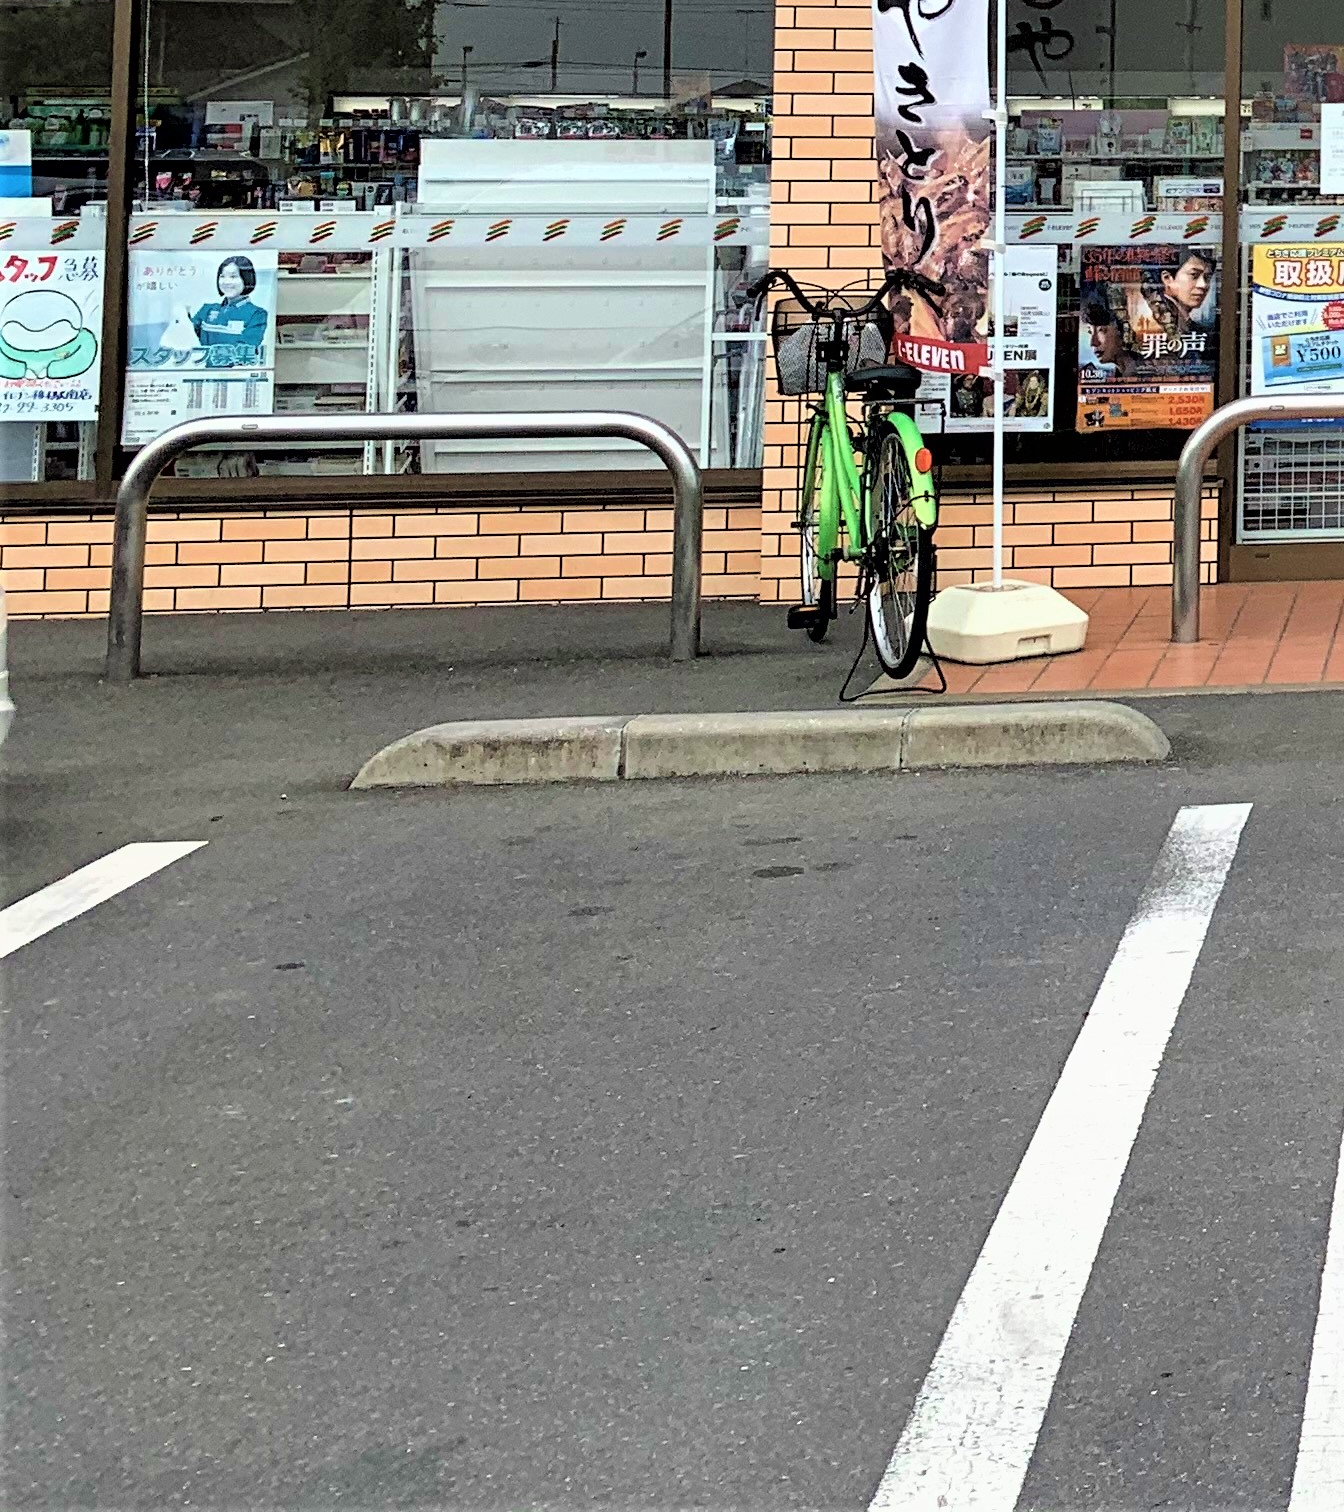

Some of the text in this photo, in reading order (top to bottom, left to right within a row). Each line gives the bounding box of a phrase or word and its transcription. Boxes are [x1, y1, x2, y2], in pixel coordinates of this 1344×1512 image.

[0, 255, 99, 282] タッフ 急募
[131, 345, 266, 366] スタッフ募集!
[1141, 331, 1208, 359] 罪の声
